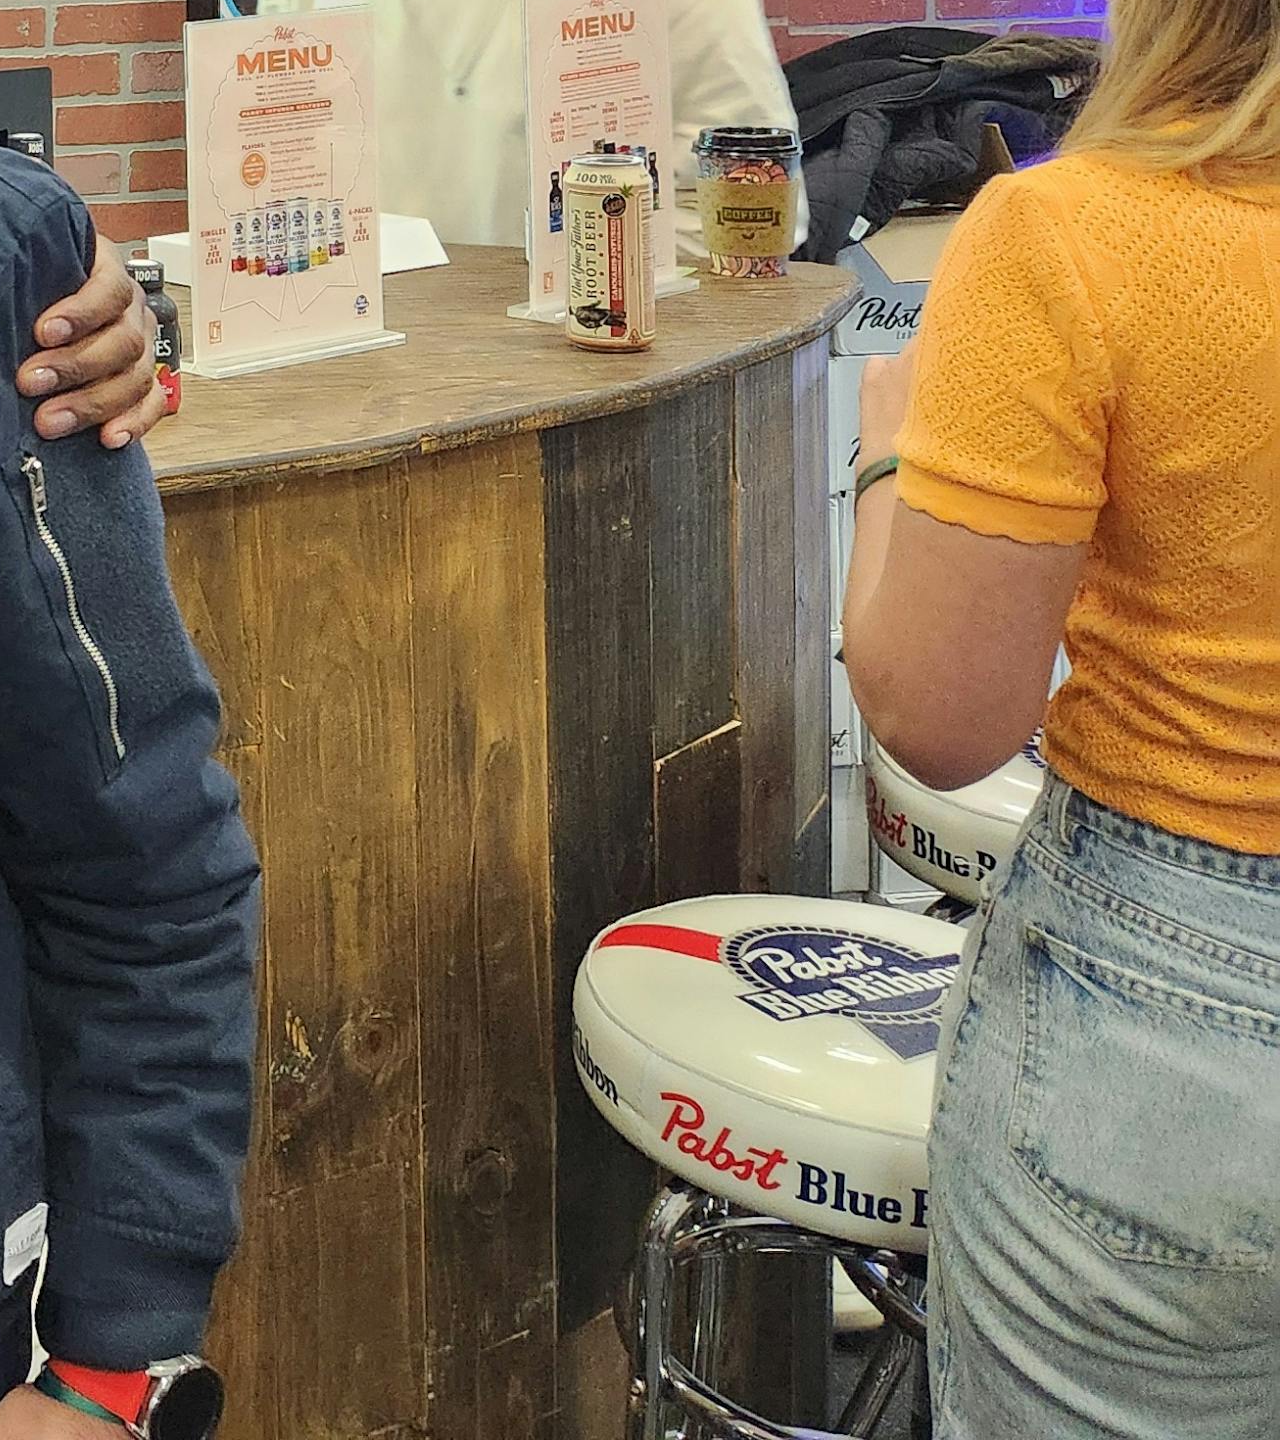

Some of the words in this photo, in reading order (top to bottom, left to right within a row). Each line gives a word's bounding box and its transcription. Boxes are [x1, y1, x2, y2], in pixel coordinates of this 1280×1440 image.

[561, 11, 635, 41] MENU
[236, 44, 333, 76] MENU
[575, 173, 598, 184] 100
[584, 210, 597, 252] BEER
[723, 208, 774, 221] COFFEE
[134, 270, 151, 282] 100
[585, 257, 598, 299] ROOT
[855, 296, 924, 331] Pabst
[911, 822, 971, 878] Blue
[741, 940, 883, 985] Pabst
[744, 987, 860, 1021] Blue
[659, 1091, 790, 1191] Pabst
[794, 1160, 903, 1226] Blue
